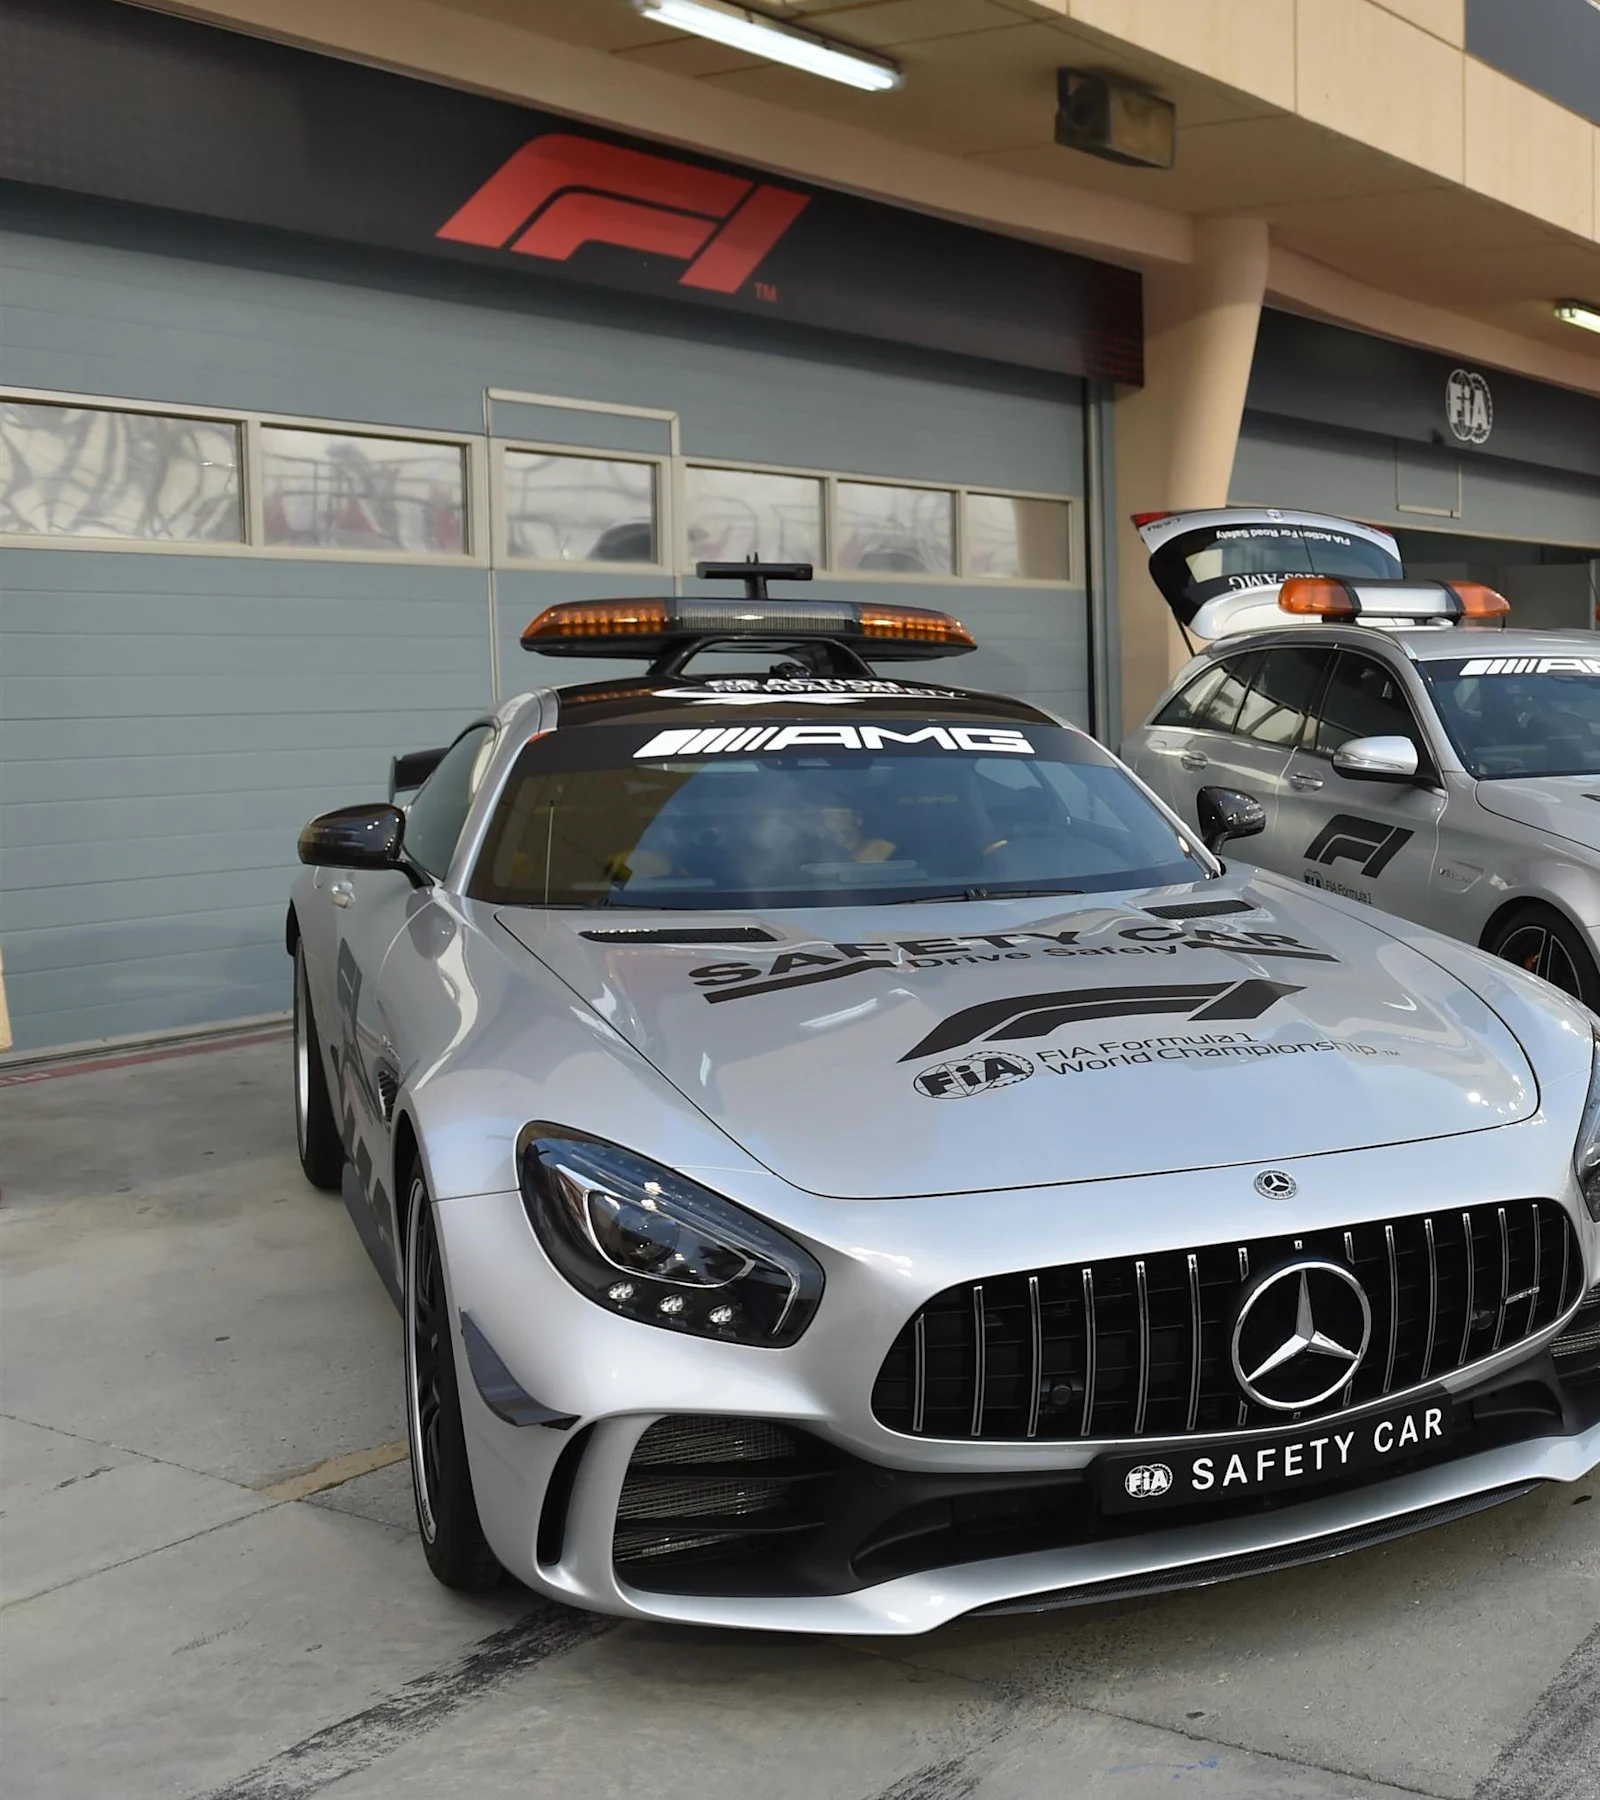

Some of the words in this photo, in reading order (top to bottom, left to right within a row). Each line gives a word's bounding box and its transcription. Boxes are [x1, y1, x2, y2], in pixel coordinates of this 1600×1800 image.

[754, 281, 778, 302] TM
[761, 684, 847, 693] ROAD
[764, 726, 1036, 755] AMG
[688, 931, 1082, 986] SAFETY
[905, 951, 1032, 968] Drive
[1042, 944, 1179, 957] Safely
[1036, 1047, 1102, 1063] FIA
[1100, 1032, 1236, 1053] Formula
[1237, 1031, 1260, 1044] 1
[1045, 1050, 1153, 1076] World
[1152, 1038, 1378, 1061] Championship
[1190, 1430, 1357, 1491] SAFETY
[1373, 1407, 1443, 1453] CAR
